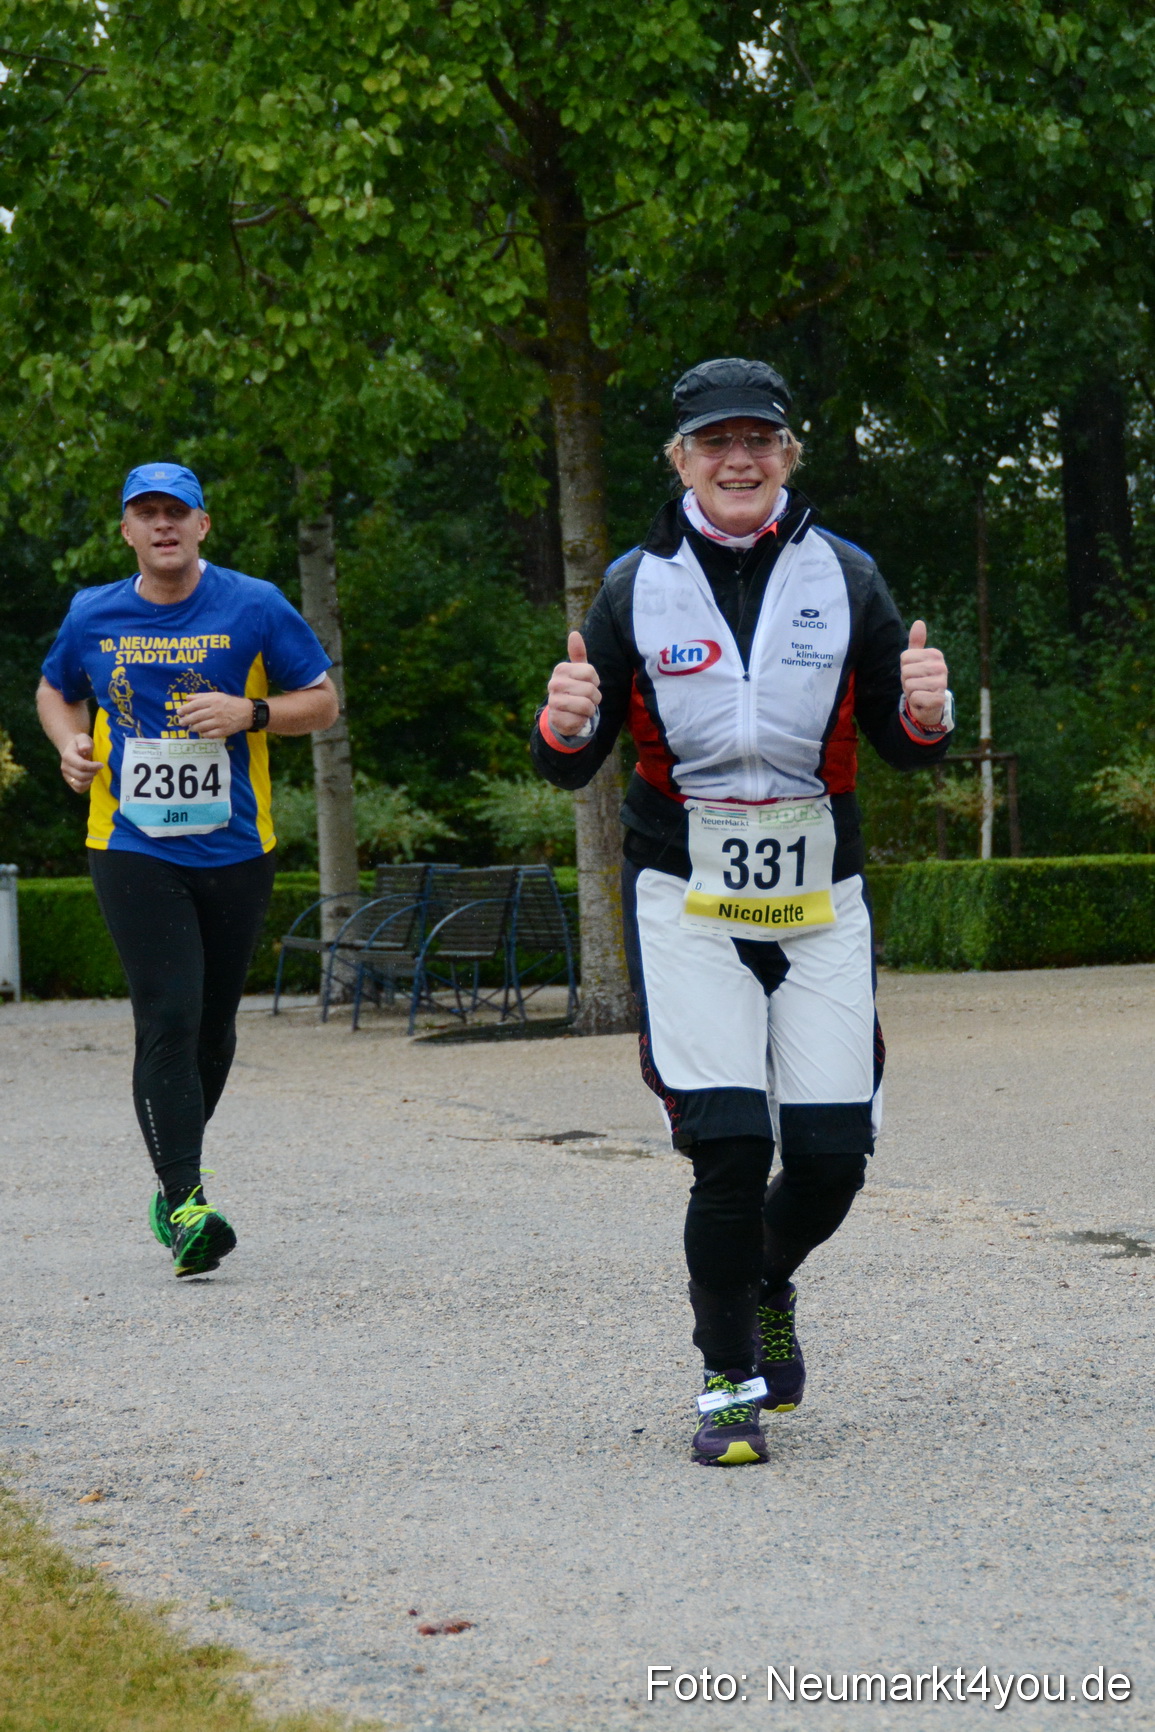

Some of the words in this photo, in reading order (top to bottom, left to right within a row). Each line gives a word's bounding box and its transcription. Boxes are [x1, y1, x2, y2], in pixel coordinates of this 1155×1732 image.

[99, 638, 117, 653] 10.
[119, 634, 231, 650] NEUMARKTER
[791, 641, 813, 650] team
[115, 649, 208, 665] STADTLAUF
[659, 644, 703, 665] tkn
[796, 650, 834, 660] klinikum
[781, 657, 822, 669] nürnberg
[168, 742, 220, 755] BOCK
[133, 763, 222, 799] 2364
[163, 809, 189, 823] Jan
[701, 816, 750, 827] NeuerMarkt
[759, 804, 822, 824] BOCK
[721, 836, 806, 890] 331
[718, 903, 804, 924] Nicolette
